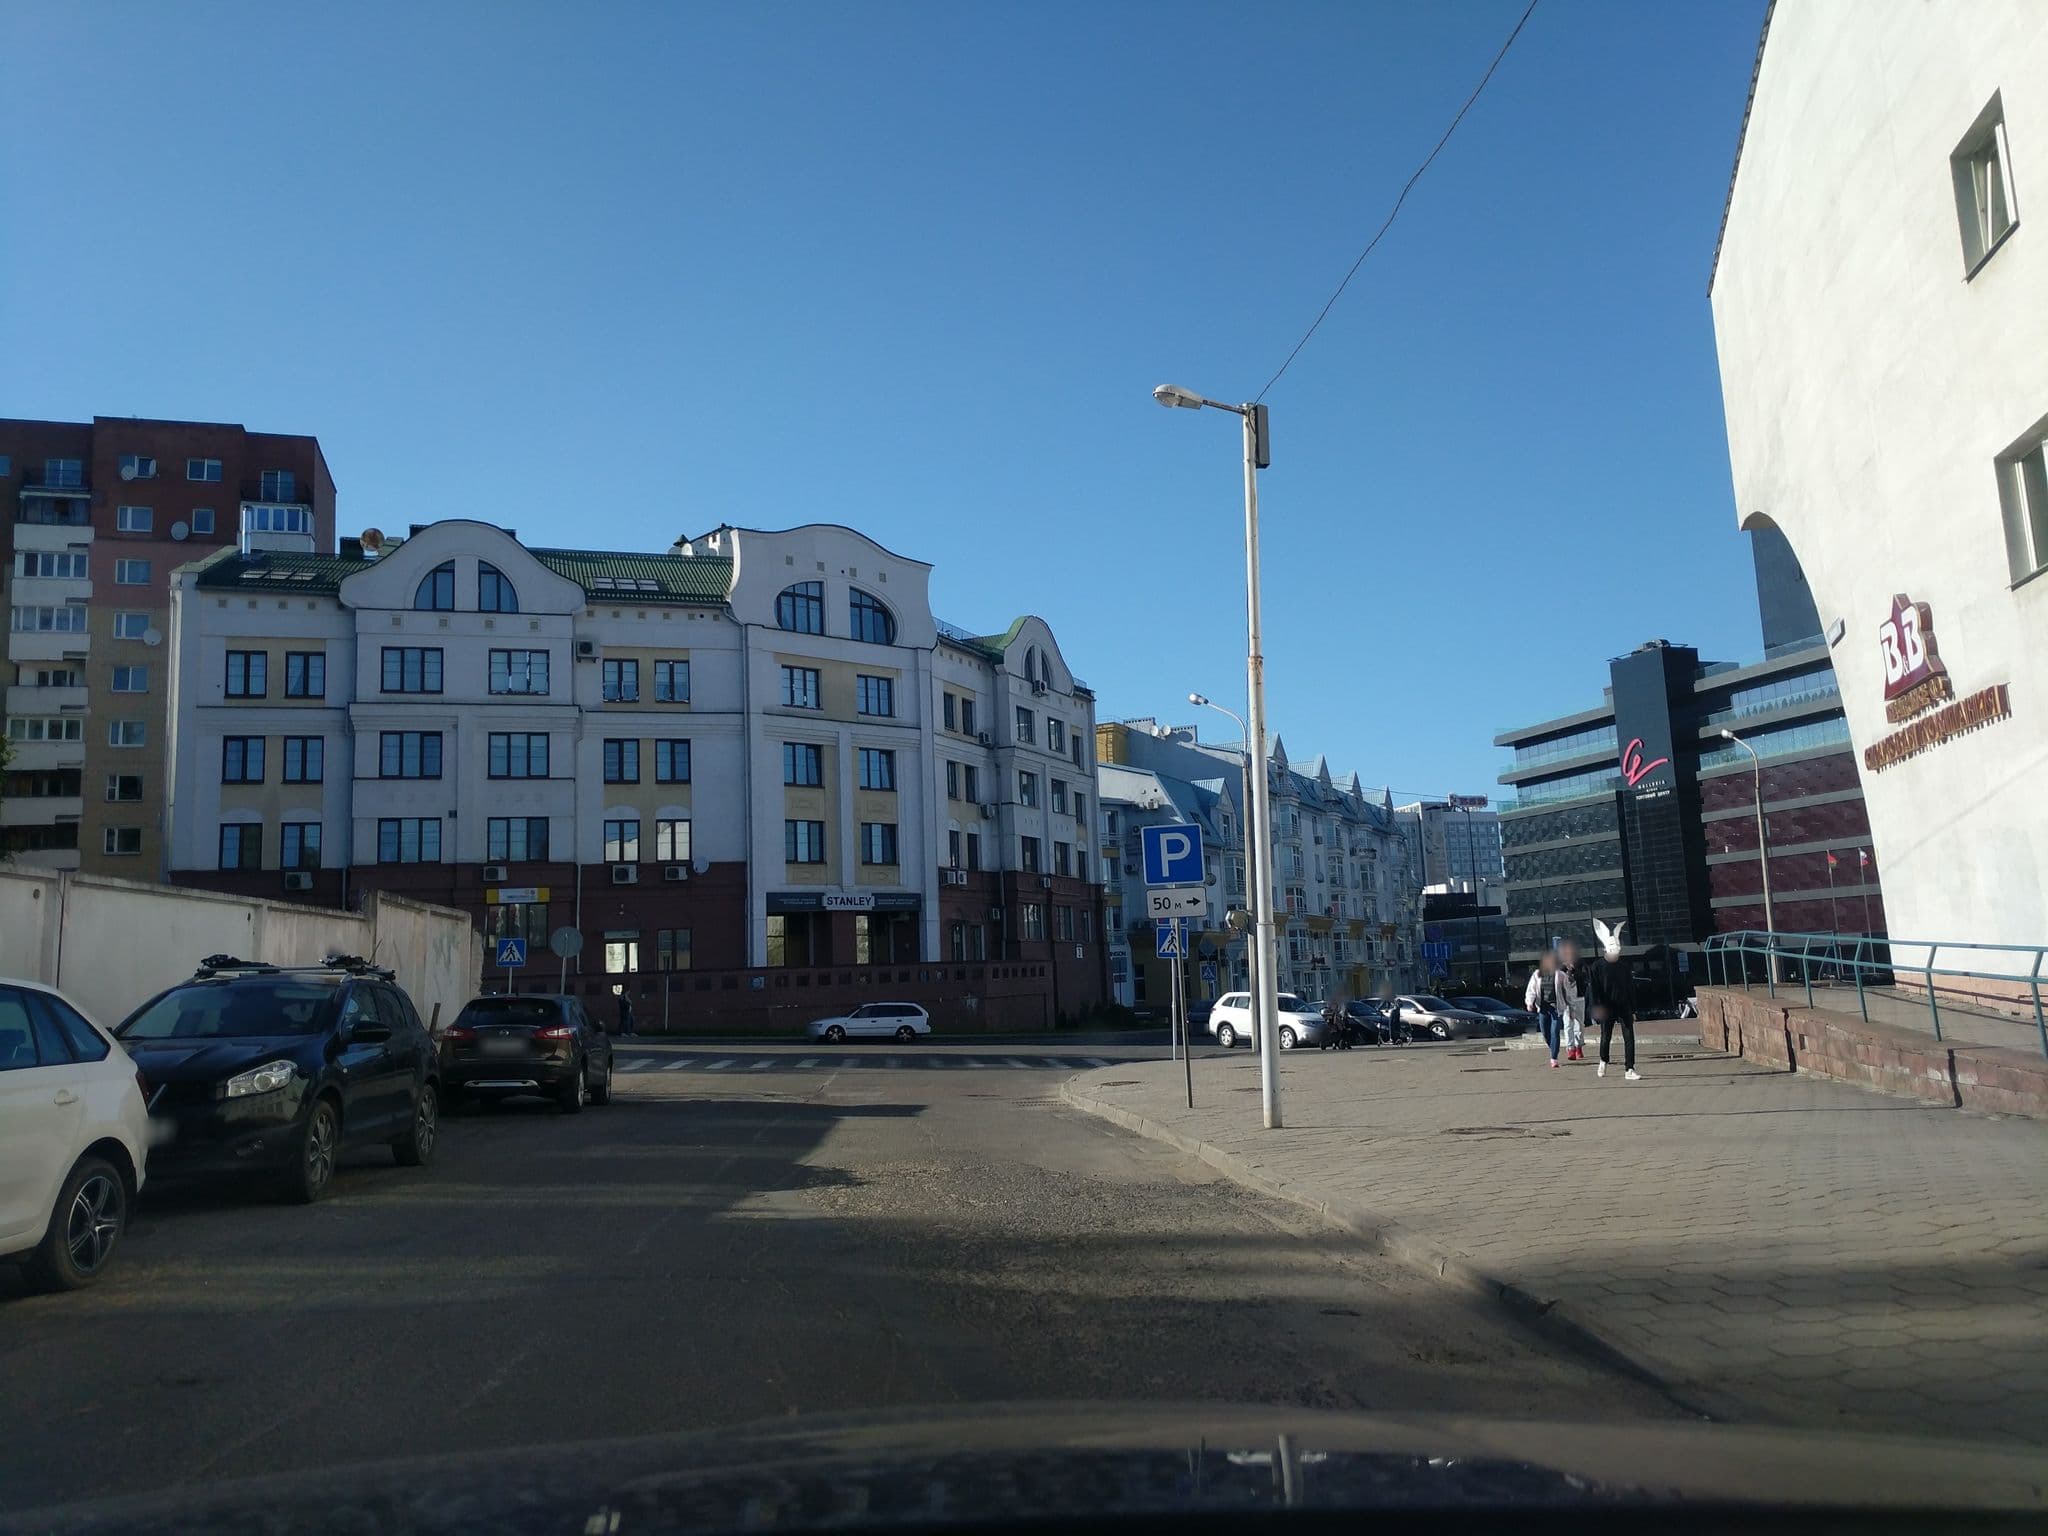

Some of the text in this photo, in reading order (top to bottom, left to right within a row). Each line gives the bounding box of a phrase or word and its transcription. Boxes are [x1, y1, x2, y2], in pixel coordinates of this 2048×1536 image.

[1160, 832, 1191, 877] P
[826, 895, 872, 906] STANLEY
[1153, 897, 1171, 911] 50
